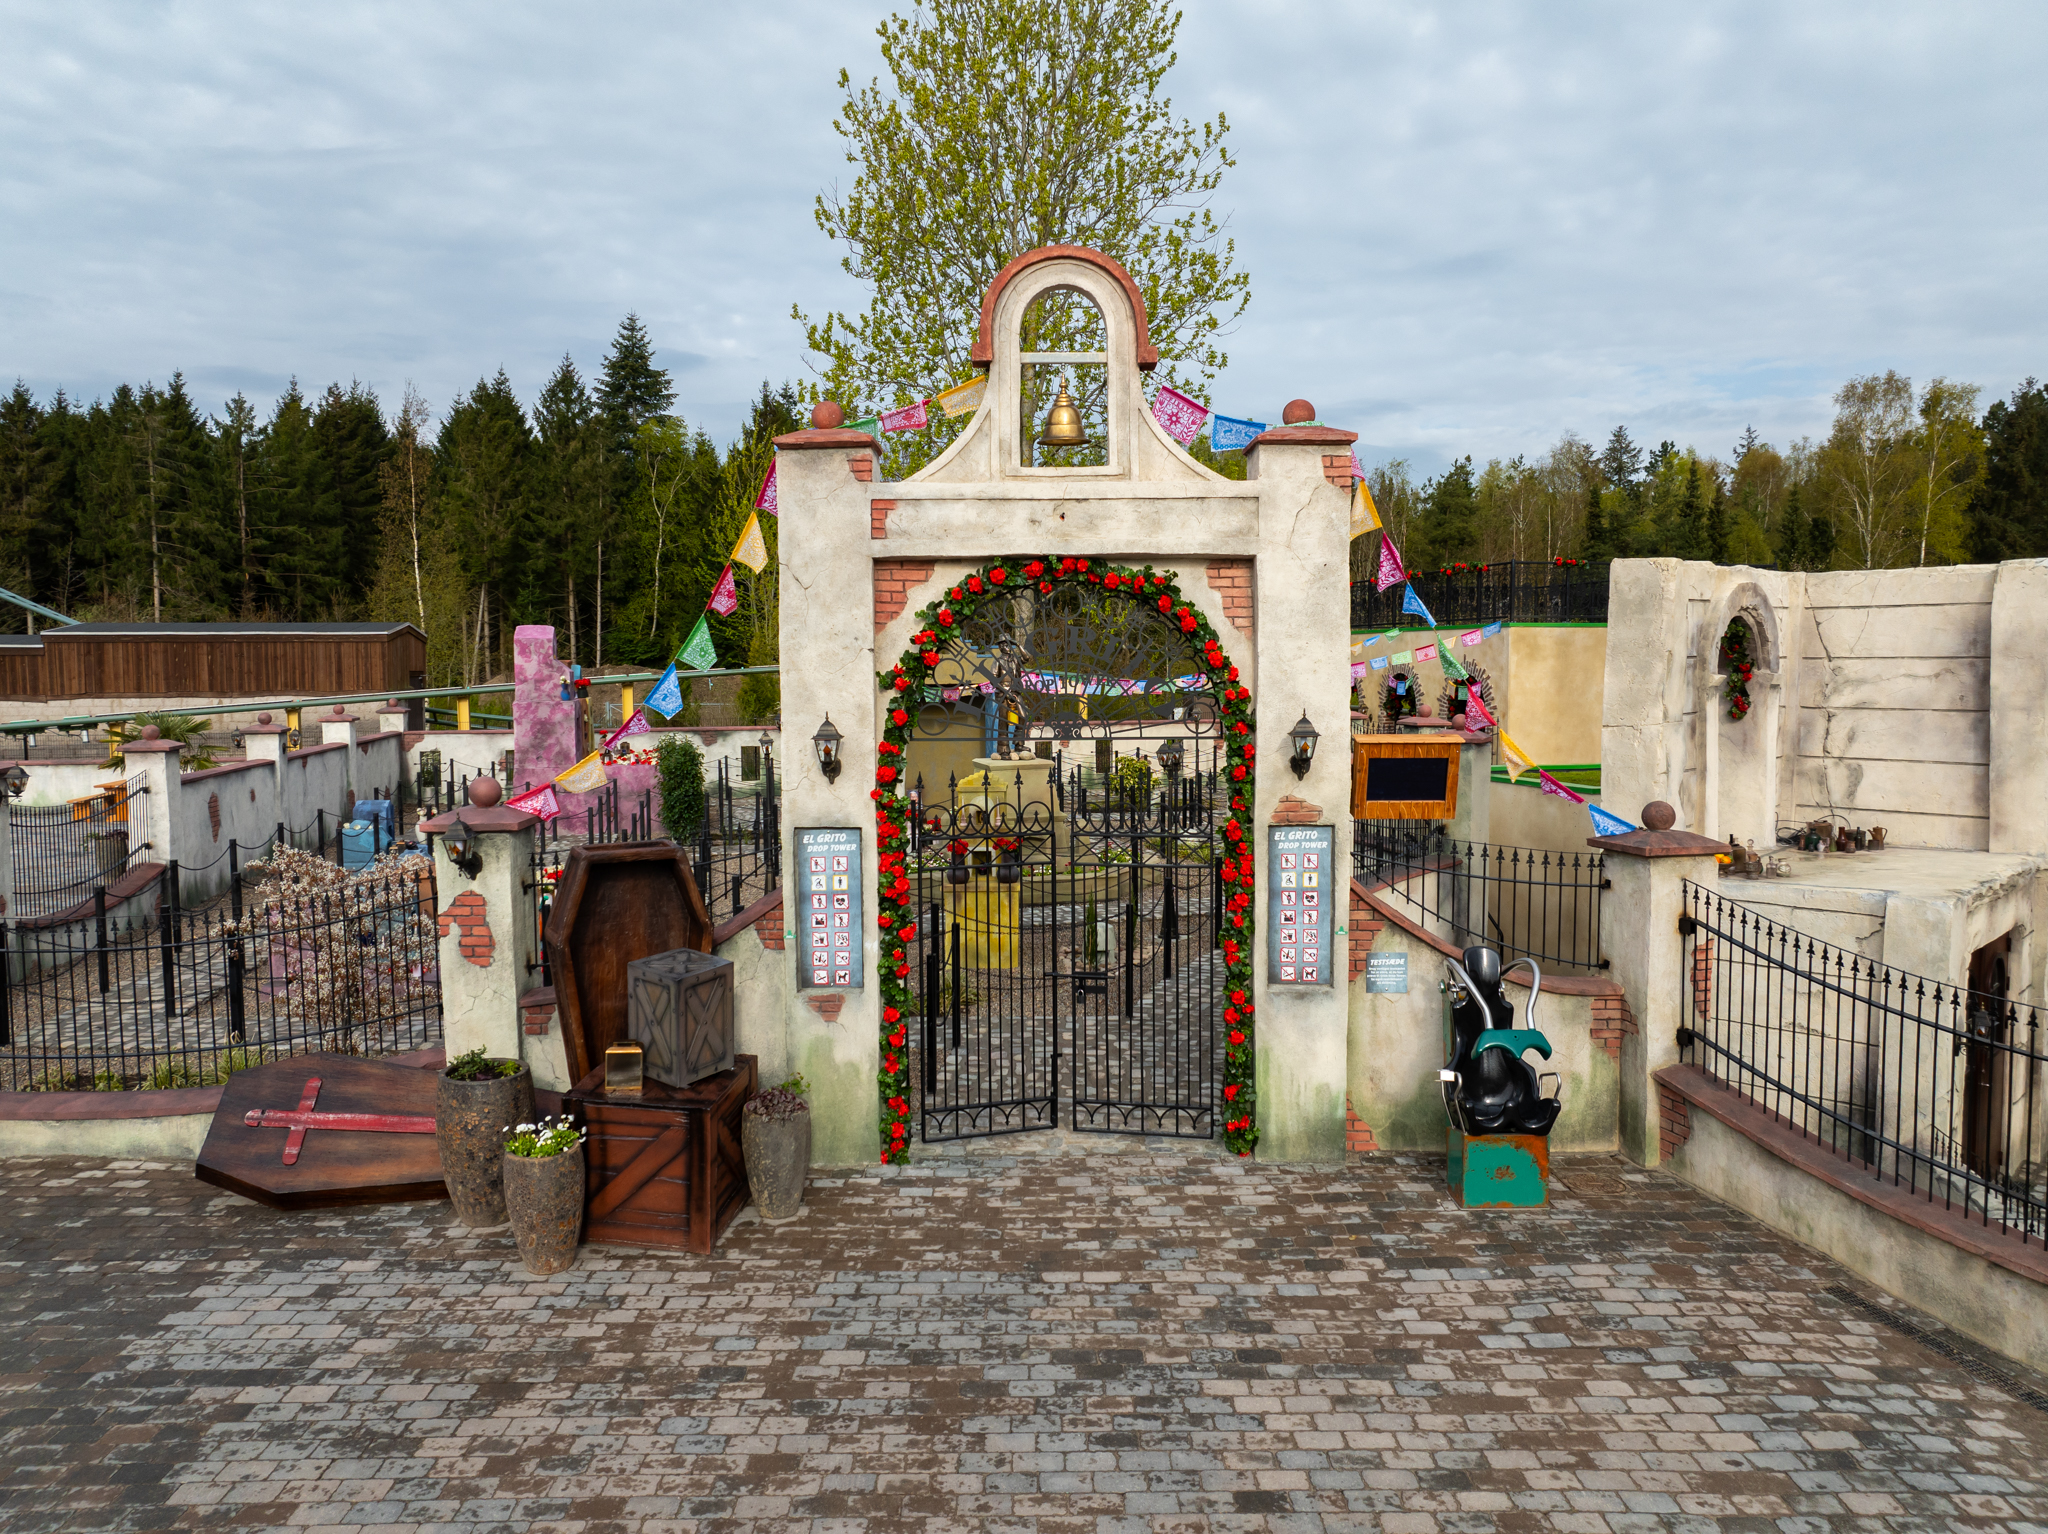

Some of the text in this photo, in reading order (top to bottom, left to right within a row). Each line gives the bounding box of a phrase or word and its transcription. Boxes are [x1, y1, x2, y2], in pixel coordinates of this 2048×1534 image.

[1025, 626, 1175, 718] GRITO
[803, 833, 847, 843] EL GRITO
[1274, 831, 1318, 840] EL GRITO
[830, 843, 857, 851] TOWER
[1278, 841, 1328, 849] DROP TOWER
[1370, 958, 1405, 966] TESTSÆDE
